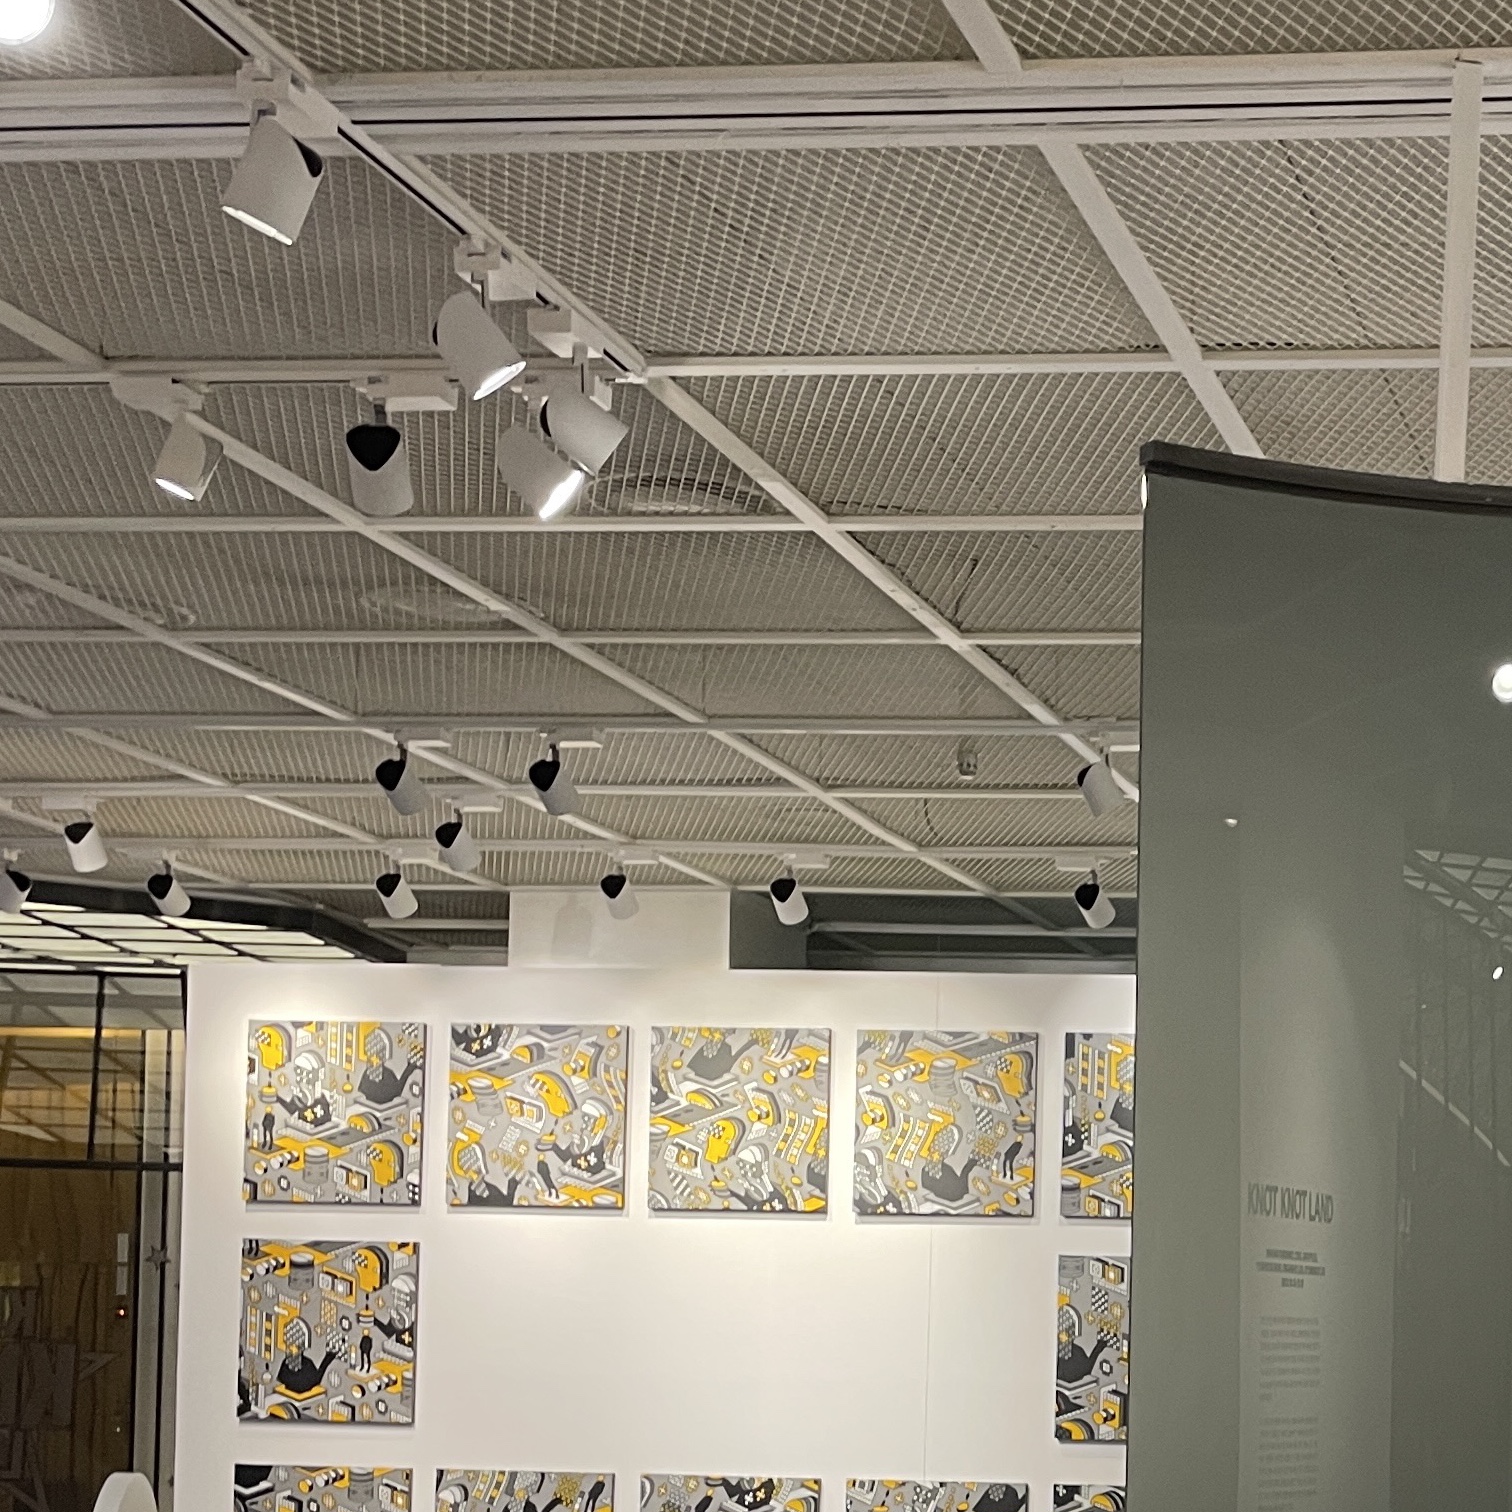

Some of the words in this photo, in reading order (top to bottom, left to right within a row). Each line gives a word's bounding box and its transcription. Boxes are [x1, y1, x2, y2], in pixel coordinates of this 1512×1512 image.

[1248, 1182, 1278, 1217] KNOT
[1280, 1187, 1307, 1220] KNOT
[1308, 1190, 1334, 1224] LAND
